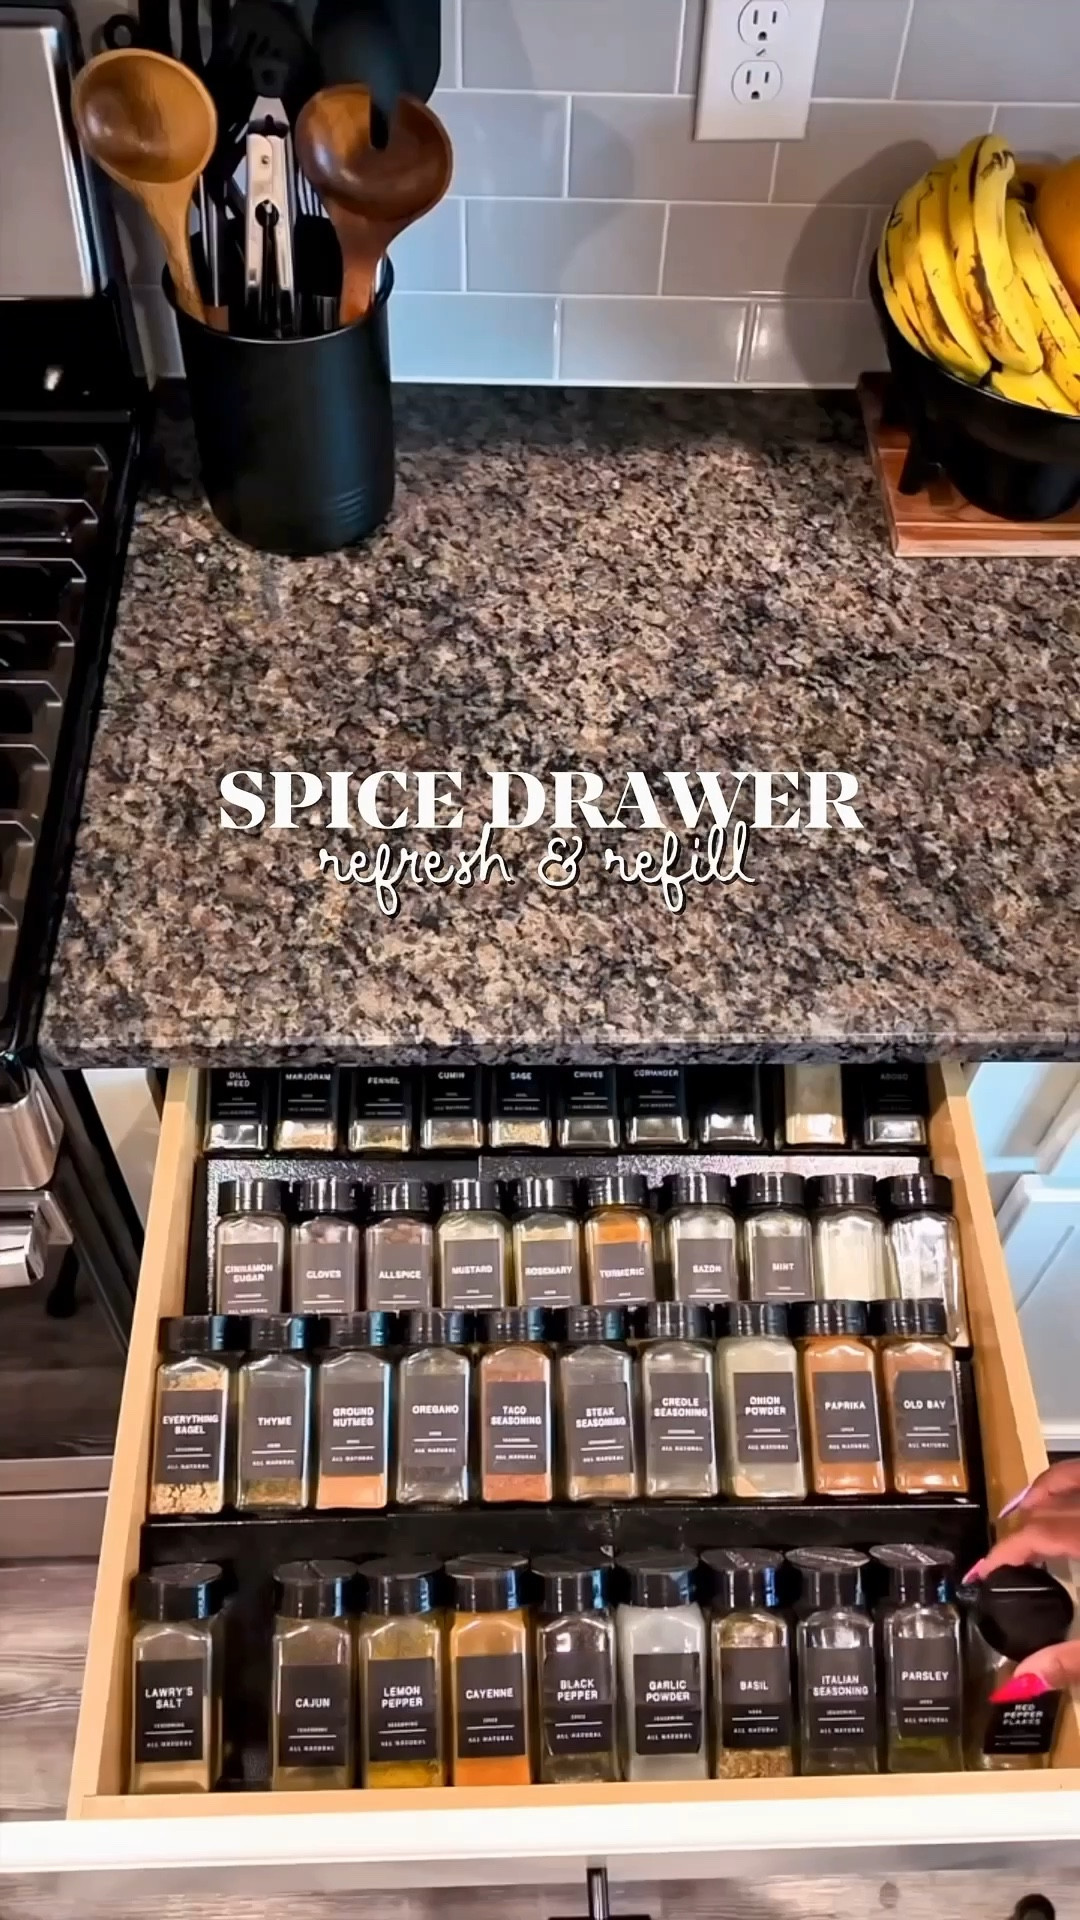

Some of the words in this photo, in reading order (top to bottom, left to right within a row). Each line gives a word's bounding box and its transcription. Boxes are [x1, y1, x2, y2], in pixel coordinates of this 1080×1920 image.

[229, 1071, 248, 1079] DILL
[285, 1073, 331, 1081] MARJORAM
[438, 1072, 466, 1080] CUMIN
[510, 1072, 533, 1080] SAGE
[573, 1070, 604, 1079] CHIVES
[633, 1069, 679, 1077] CORIANDER
[226, 1079, 251, 1087] WEED
[367, 1077, 401, 1085] FENNEL
[224, 1264, 274, 1275] CINNAMON
[451, 1265, 493, 1275] MUSTARD
[525, 1265, 573, 1276] ROSEMARY
[599, 1267, 645, 1278] TURMERIC
[692, 1264, 722, 1274] SAZON
[772, 1262, 795, 1272] MINT
[233, 1273, 265, 1283] SUGAR
[306, 1270, 342, 1280] CLOVES
[378, 1270, 423, 1280] ALLSPICE
[661, 1397, 700, 1407] CREOLE
[749, 1396, 781, 1406] ONION
[824, 1400, 867, 1411] PAPRIKA
[903, 1399, 924, 1410] OLD
[926, 1399, 947, 1410] BAY
[332, 1407, 375, 1417] GROUND
[412, 1405, 460, 1415] OREGANO
[502, 1405, 528, 1416] TACO
[585, 1407, 615, 1418] STEAK
[653, 1406, 709, 1418] SEASONING
[744, 1405, 787, 1416] POWDER
[162, 1414, 220, 1425] EVERYTHING
[257, 1416, 293, 1427] THYME
[332, 1417, 374, 1428] NUTMEG
[490, 1416, 542, 1426] SEASONING
[575, 1416, 627, 1428] SEASONING
[174, 1424, 206, 1435] BAGEL
[821, 1674, 860, 1685] ITALIAN
[901, 1671, 949, 1682] PARSLEY
[560, 1678, 595, 1690] BLACK
[649, 1680, 687, 1691] GARLIC
[739, 1680, 769, 1691] BASIL
[145, 1686, 194, 1698] LAWRY'S
[383, 1685, 421, 1698] LEMON
[465, 1688, 514, 1700] CAYENNE
[557, 1690, 598, 1701] PEPPER
[646, 1691, 690, 1702] POWDER
[812, 1686, 869, 1697] SEASONING
[156, 1699, 183, 1710] SALT
[295, 1698, 331, 1709] CAJUN
[381, 1697, 423, 1709] PEPPER
[1015, 1703, 1036, 1711] RED
[1002, 1718, 1042, 1726] FLAKES
